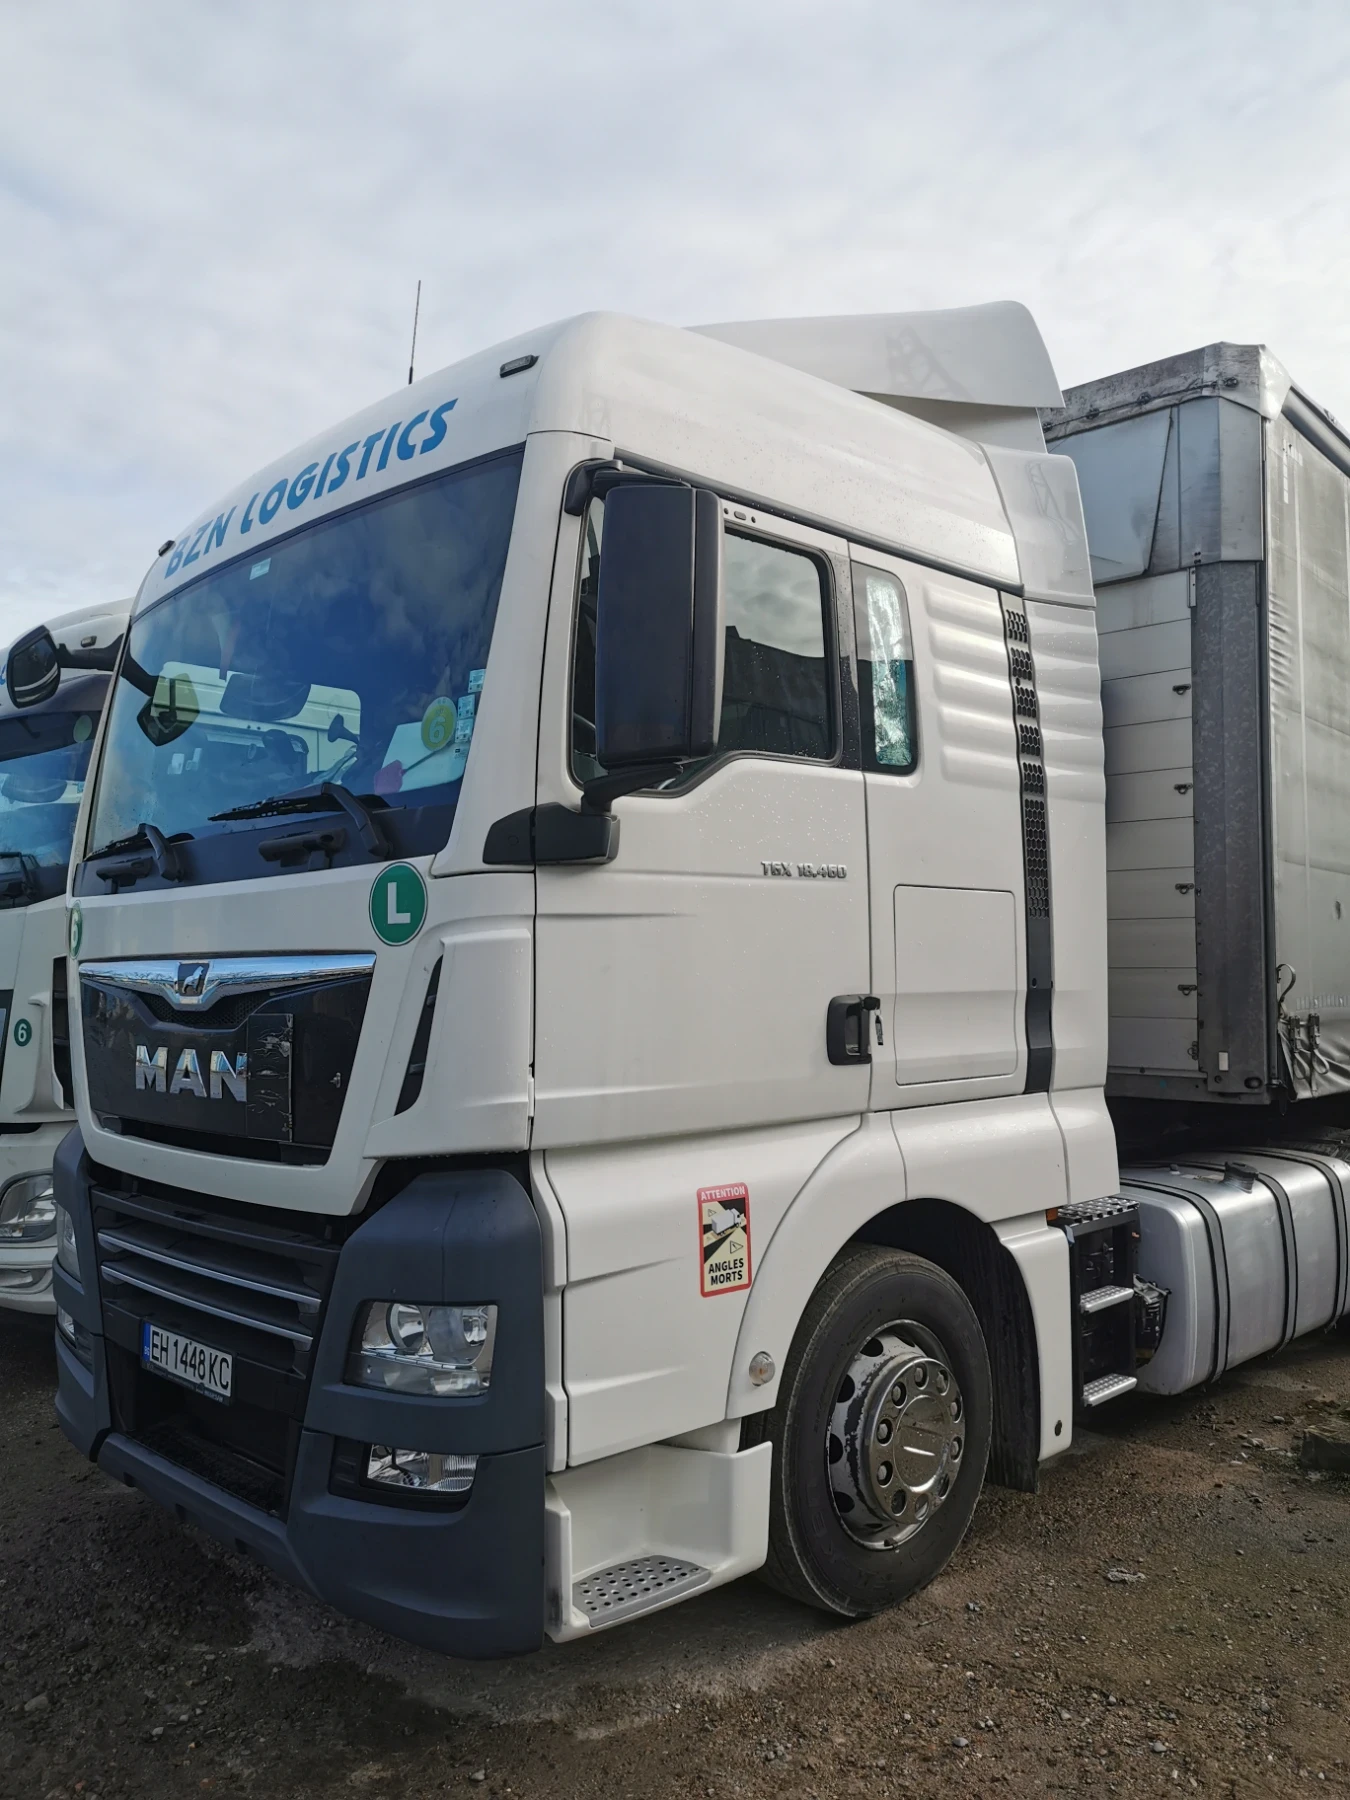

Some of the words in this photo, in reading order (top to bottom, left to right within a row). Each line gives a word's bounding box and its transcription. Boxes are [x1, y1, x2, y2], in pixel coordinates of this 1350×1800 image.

[164, 505, 237, 579] BZN
[240, 397, 459, 534] LOGISTICS
[429, 716, 446, 743] 6
[761, 860, 793, 877] TGX
[387, 881, 411, 925] L
[70, 911, 79, 948] 6
[18, 1023, 28, 1042] 6
[135, 1045, 248, 1102] MAN
[701, 1186, 745, 1200] ATTENTION
[708, 1257, 745, 1275] ANGLES
[711, 1270, 743, 1286] MORTS
[174, 1339, 205, 1380] 1448
[209, 1352, 229, 1390] KC
